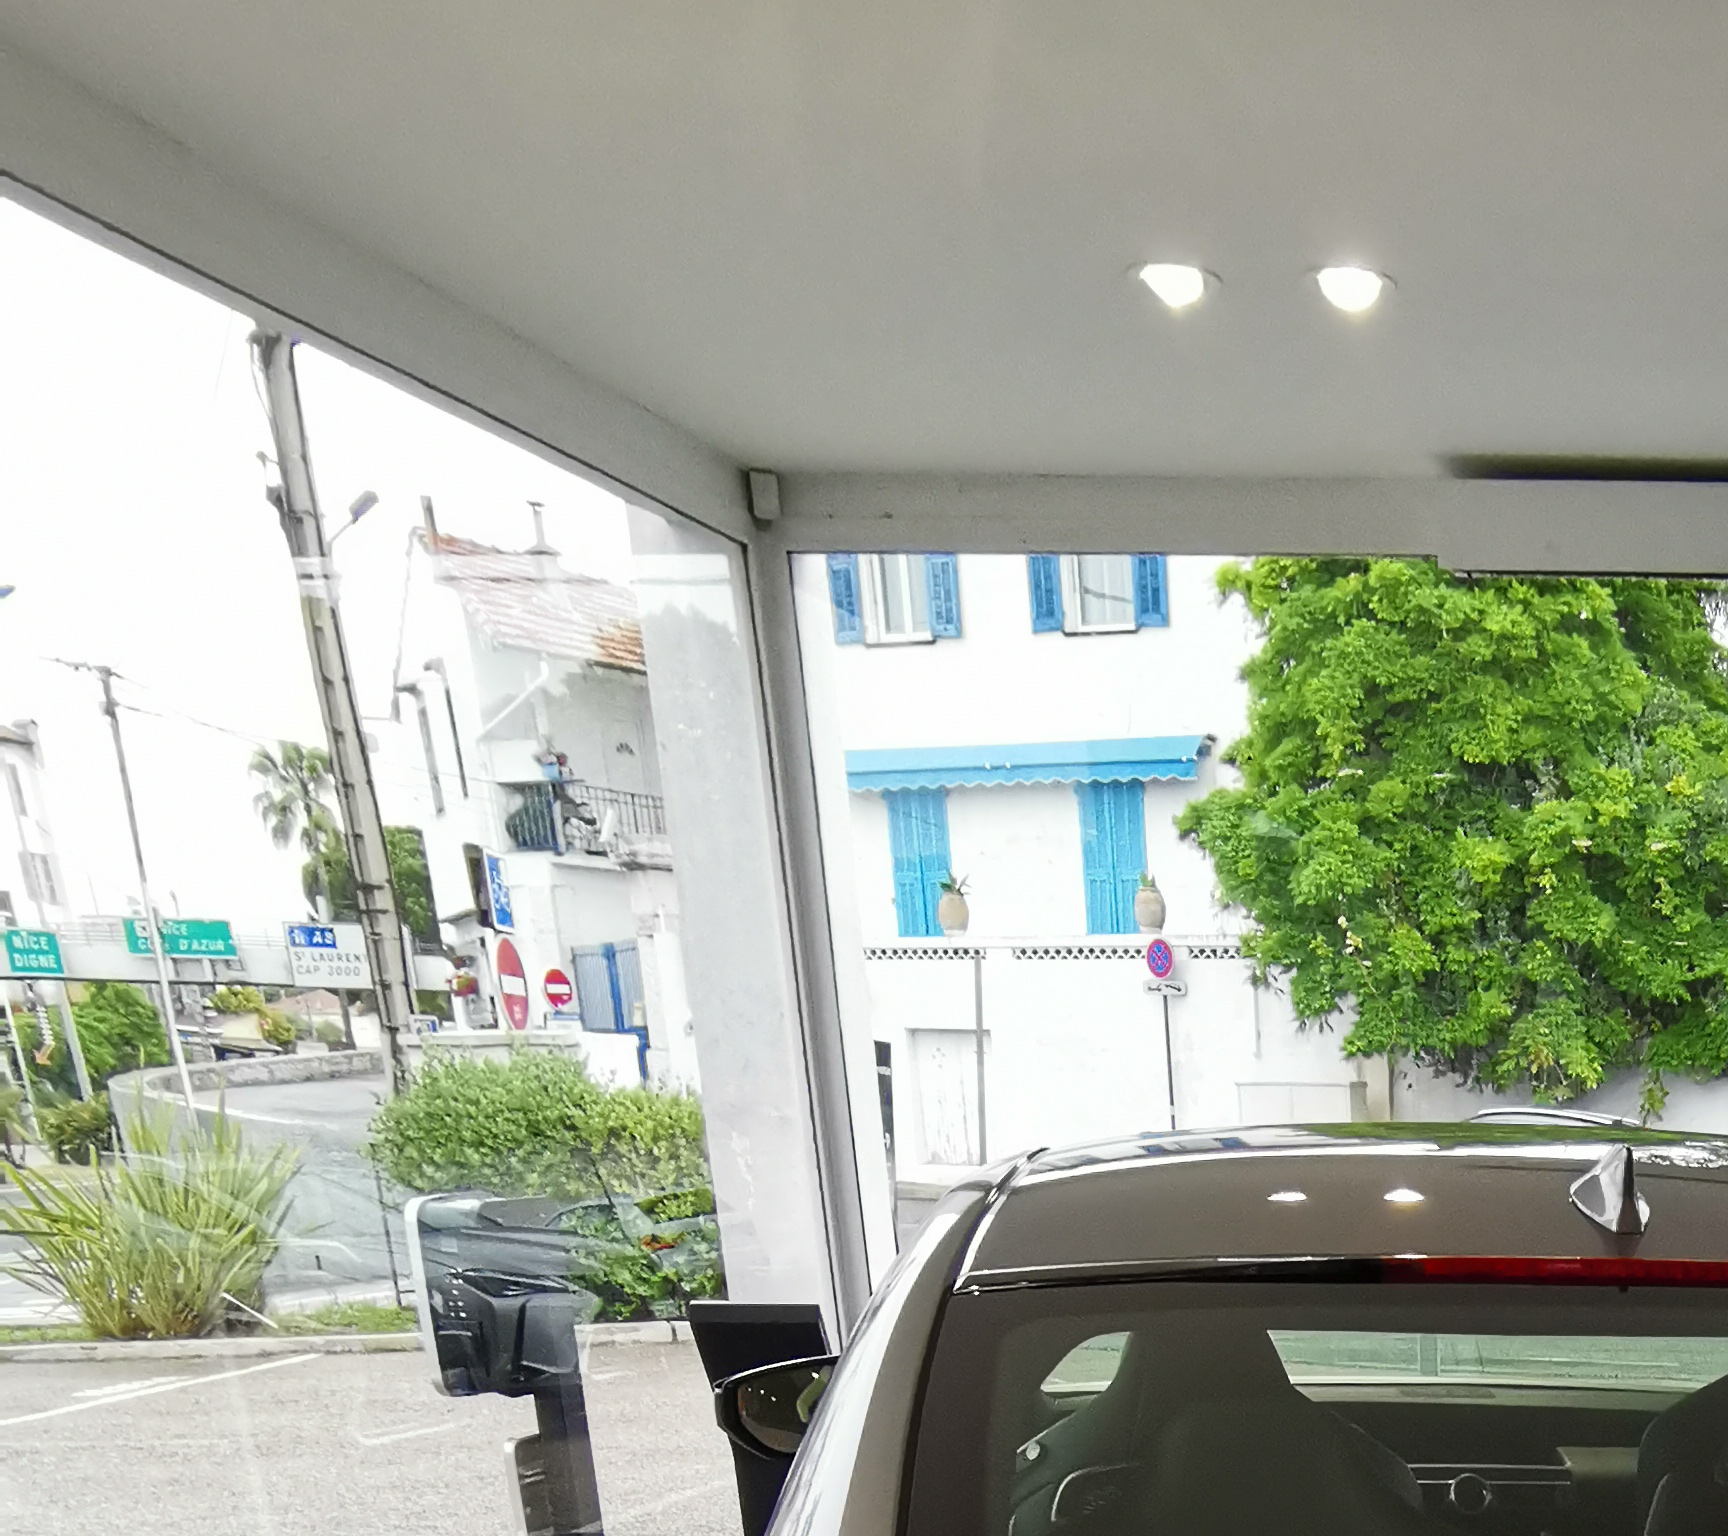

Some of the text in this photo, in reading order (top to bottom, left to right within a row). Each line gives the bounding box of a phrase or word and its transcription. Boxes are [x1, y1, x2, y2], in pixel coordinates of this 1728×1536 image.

[12, 931, 49, 950] NICE
[13, 953, 58, 969] DIGNE
[296, 964, 361, 977] CAP 3000
